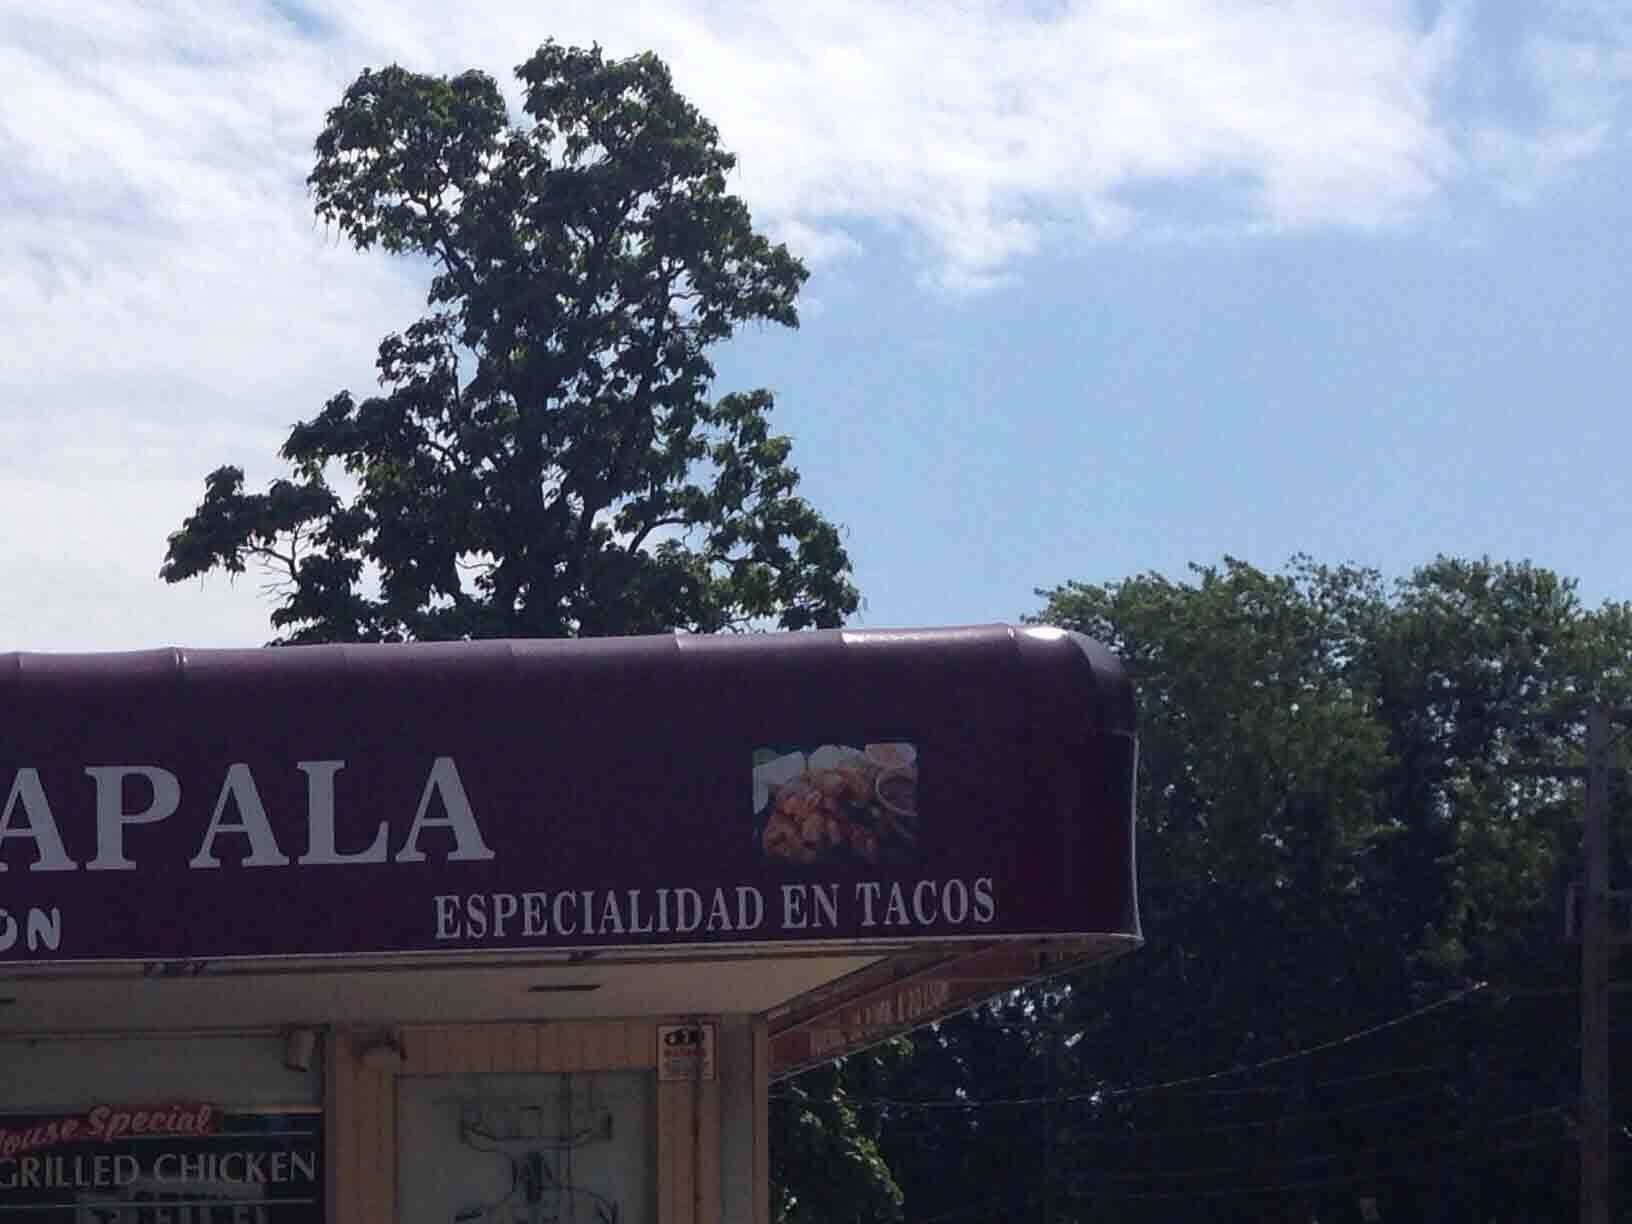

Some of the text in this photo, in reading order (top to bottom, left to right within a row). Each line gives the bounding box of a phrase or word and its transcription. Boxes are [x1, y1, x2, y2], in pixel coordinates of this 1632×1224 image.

[432, 875, 997, 941] ESPECIALIDAD EN TACOS
[86, 1103, 215, 1144] Special
[153, 1151, 319, 1185] CHICKEN
